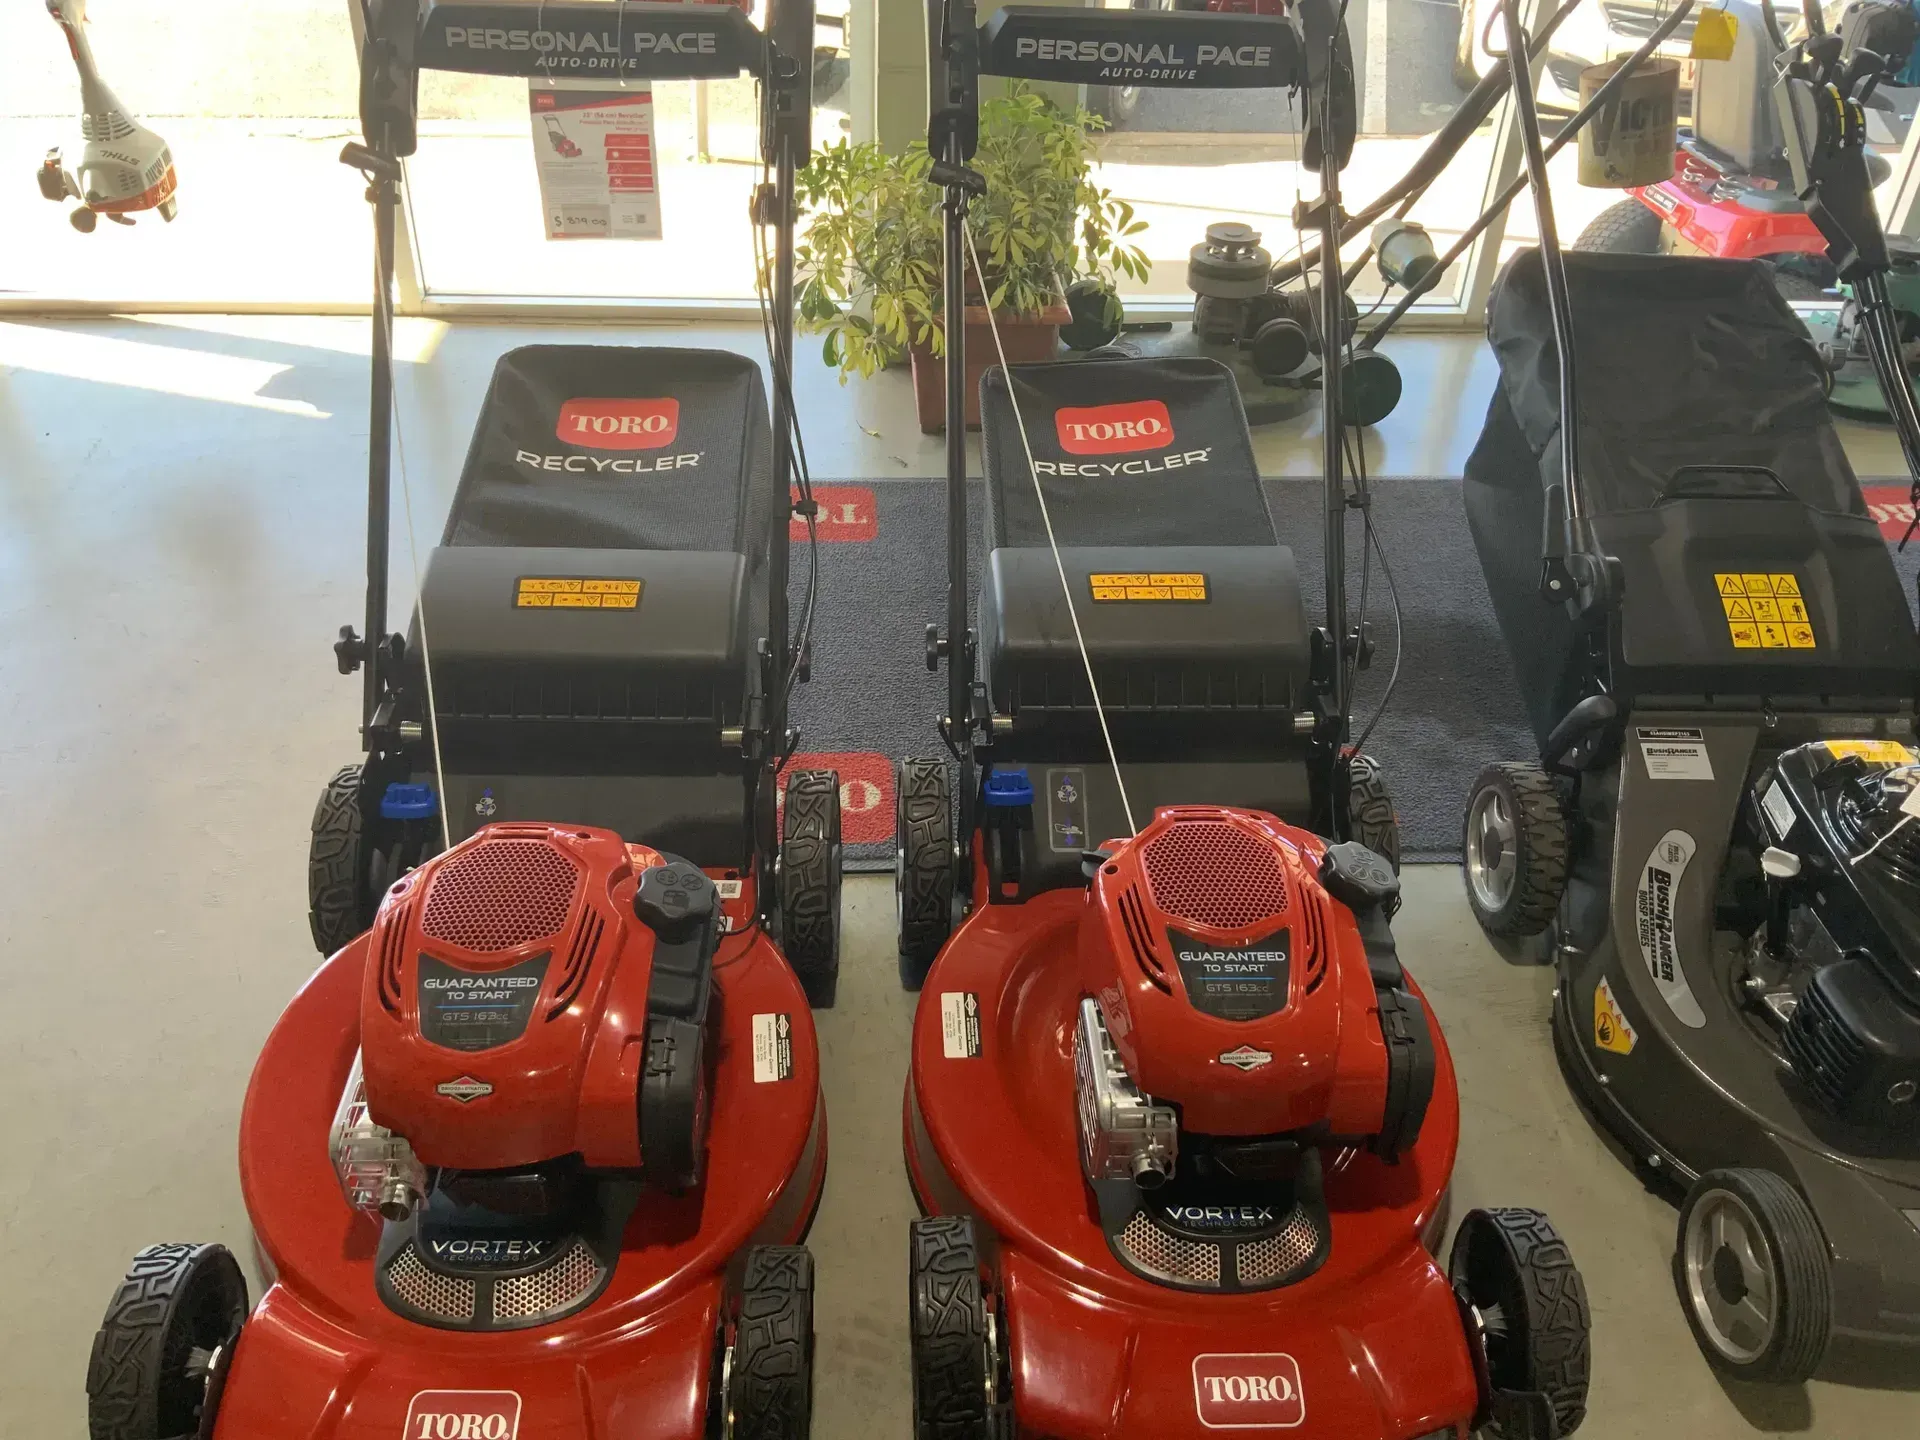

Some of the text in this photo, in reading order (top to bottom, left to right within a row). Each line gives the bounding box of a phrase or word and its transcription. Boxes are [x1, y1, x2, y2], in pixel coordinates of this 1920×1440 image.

[445, 26, 717, 54] PERSONAL PACE
[1016, 37, 1272, 67] PERSONAL PACE
[535, 56, 638, 69] AUTO-DRIVE
[1099, 67, 1197, 80] AUTO-DRIVE
[100, 149, 140, 166] STIHL
[570, 414, 669, 435] TORO
[1066, 417, 1162, 441] TORO
[515, 449, 701, 473] RECYCLER
[1034, 449, 1209, 477] RECYCLER
[1638, 889, 1650, 948] 800SP SERIES
[1180, 951, 1286, 962] GUARANTEED
[1204, 964, 1265, 972] TO START
[424, 977, 538, 989] GUARANTEED
[1206, 984, 1268, 992] GTS 163cc
[447, 990, 513, 1000] TO START
[442, 1012, 470, 1021] GTS
[1166, 1206, 1273, 1220] VORTEX
[432, 1240, 543, 1254] VORTEX
[443, 1254, 529, 1262] TECHNOLOGY
[1203, 1375, 1292, 1402] TORO
[415, 1413, 507, 1440] TORO
